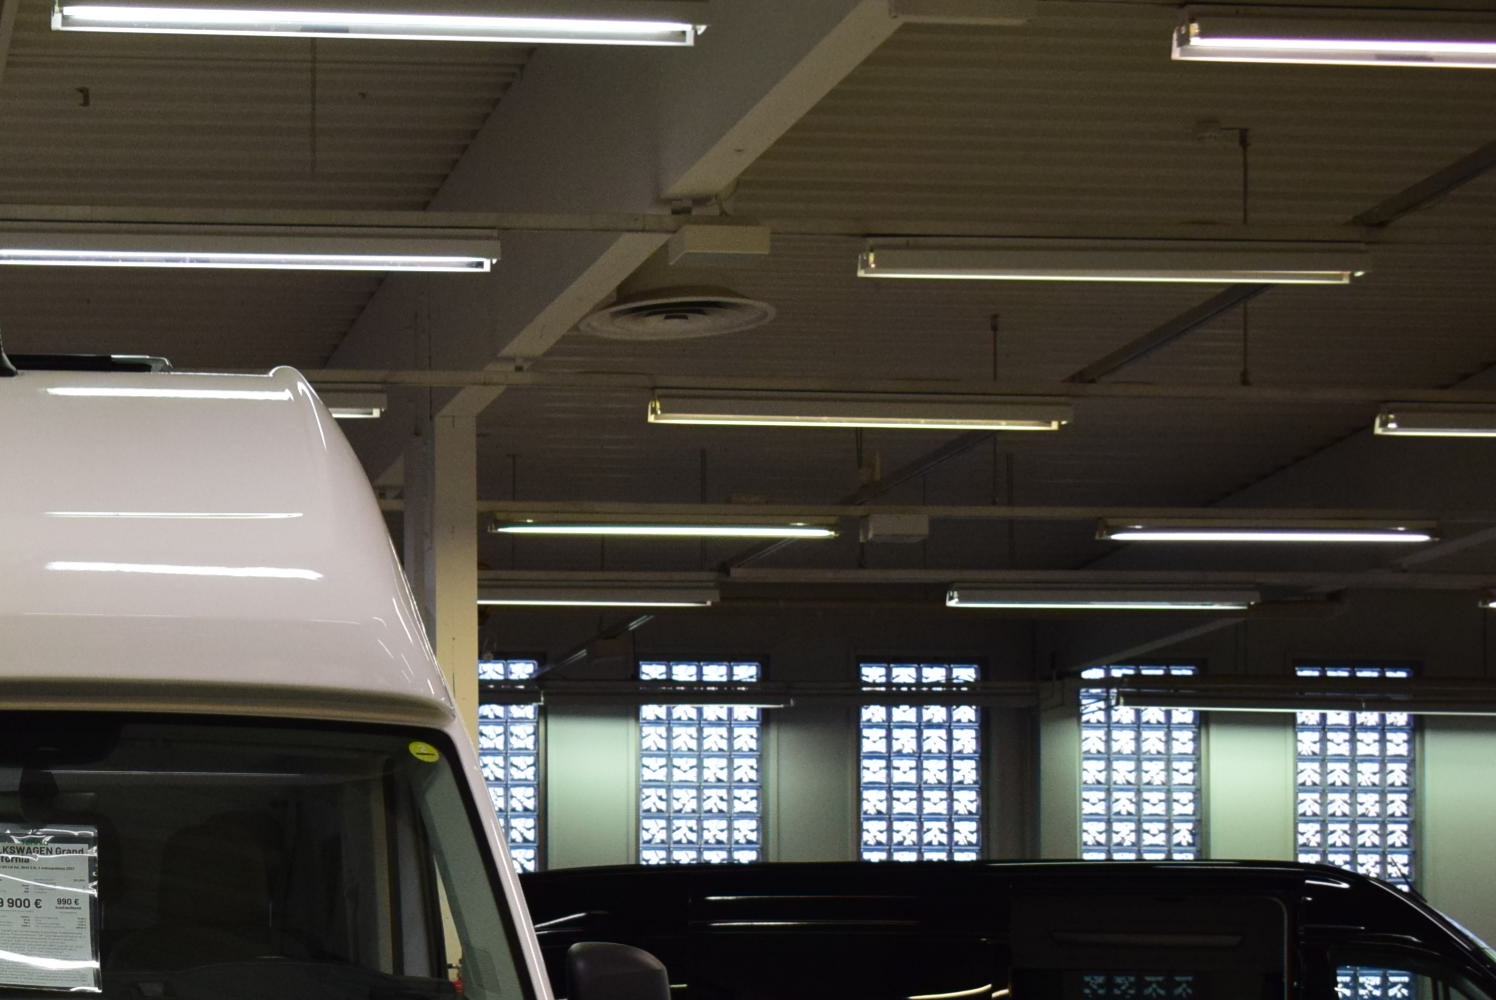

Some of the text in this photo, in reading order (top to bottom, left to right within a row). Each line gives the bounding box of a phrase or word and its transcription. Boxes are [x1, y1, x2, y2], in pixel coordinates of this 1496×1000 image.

[55, 847, 84, 855] Grand
[7, 897, 31, 909] 900
[34, 898, 43, 909] €
